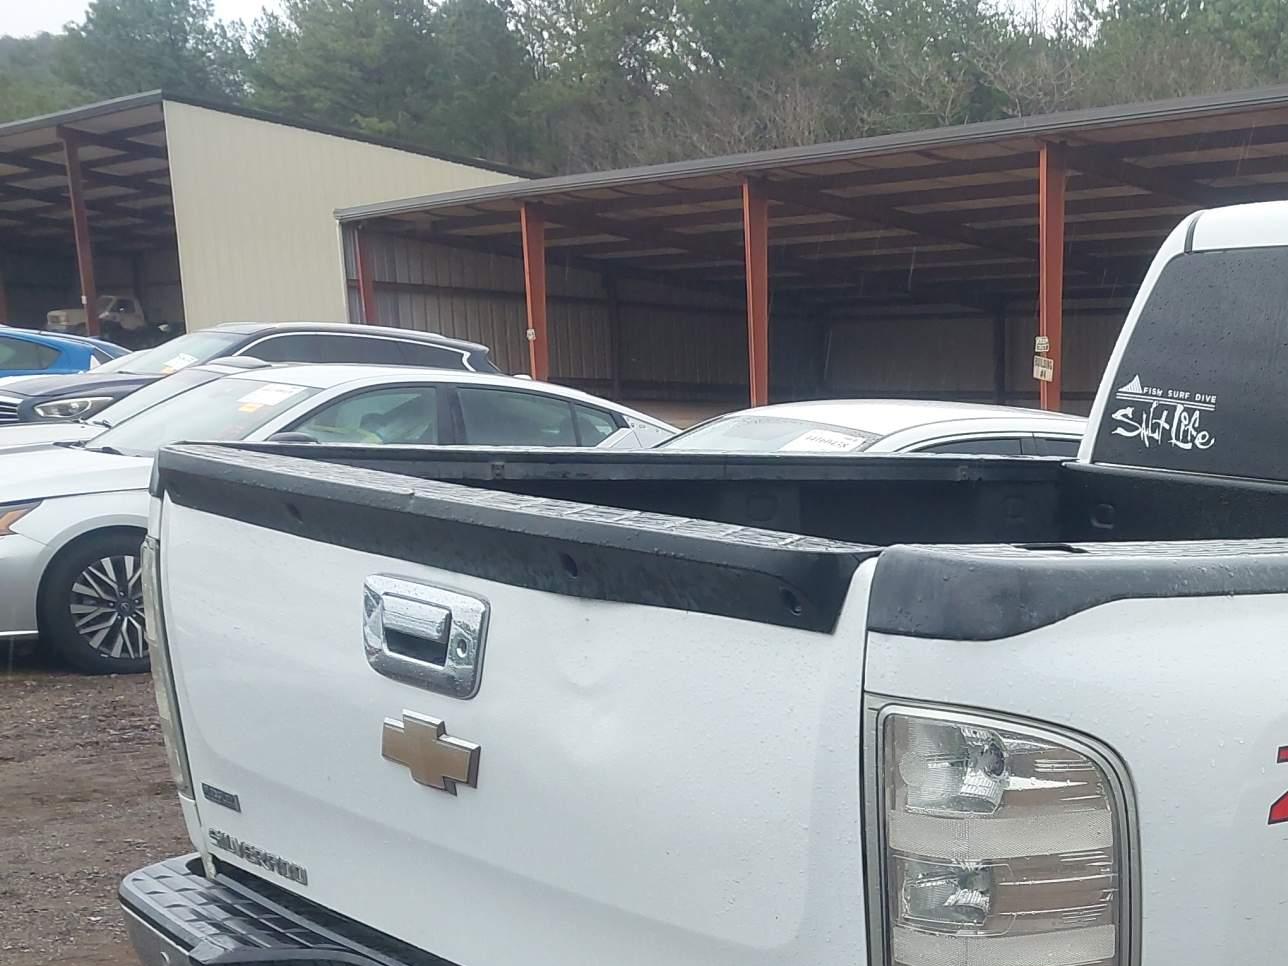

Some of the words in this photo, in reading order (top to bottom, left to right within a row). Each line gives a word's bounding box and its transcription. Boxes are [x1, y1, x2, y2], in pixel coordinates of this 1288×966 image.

[1143, 387, 1163, 397] FISH
[1168, 390, 1190, 400] SURF
[1195, 394, 1216, 403] DIVE
